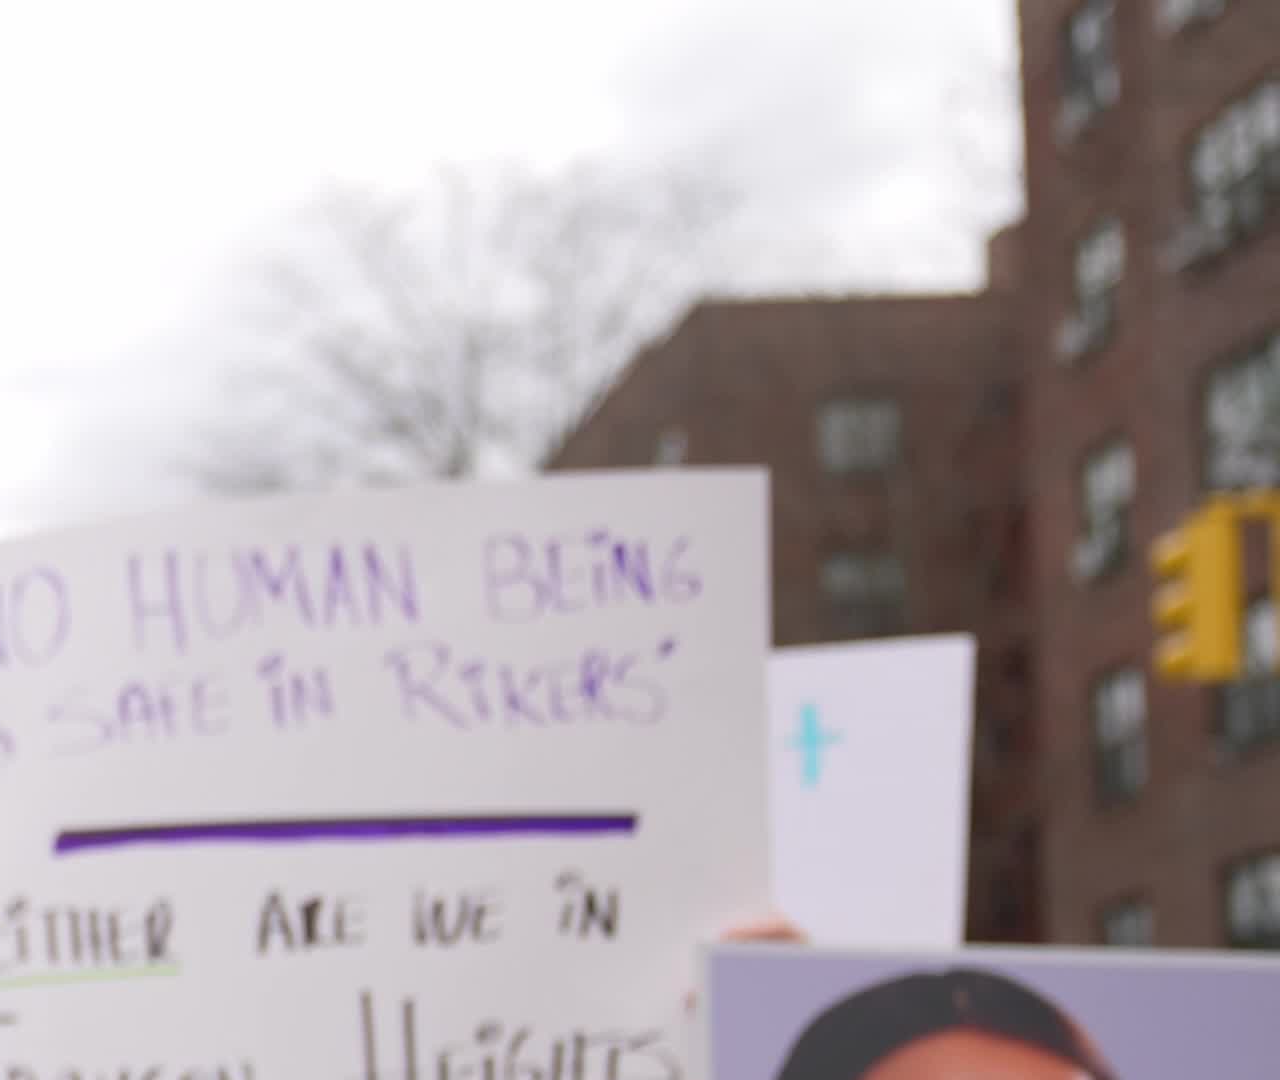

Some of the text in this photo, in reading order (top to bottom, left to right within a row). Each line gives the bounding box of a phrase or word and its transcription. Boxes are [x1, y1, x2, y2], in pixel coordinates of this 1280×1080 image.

[125, 539, 419, 655] HUMAN
[44, 669, 231, 759] SAFE
[254, 887, 366, 957] ARE
[412, 883, 502, 948] WE
